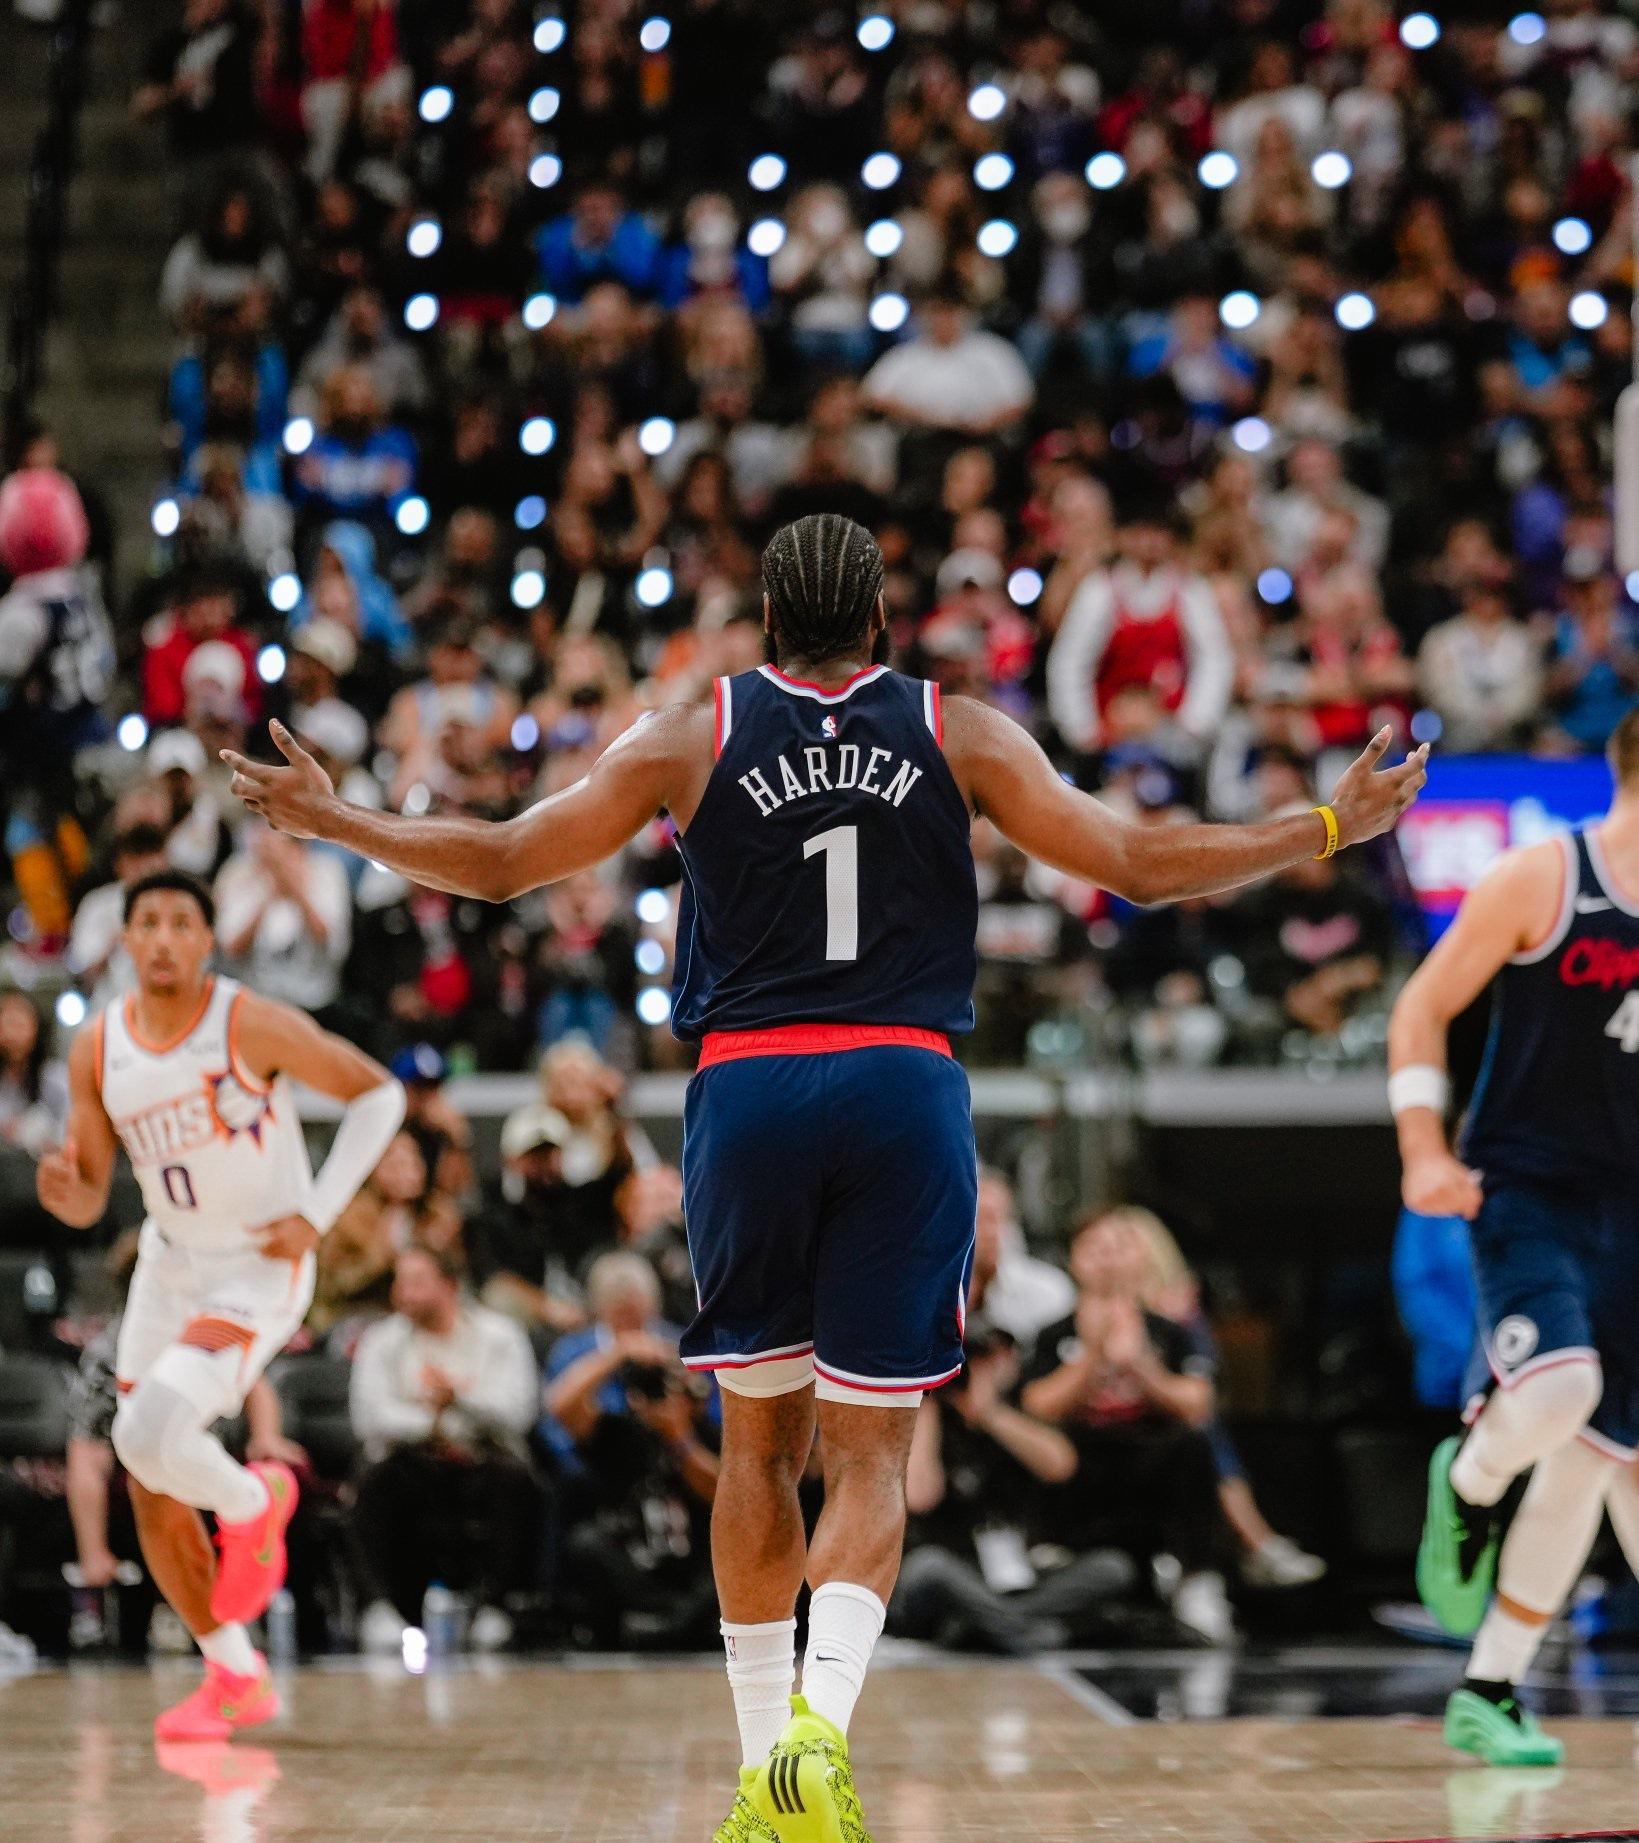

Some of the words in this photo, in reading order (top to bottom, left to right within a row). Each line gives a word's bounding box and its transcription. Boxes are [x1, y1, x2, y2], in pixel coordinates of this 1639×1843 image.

[737, 744, 923, 818] HARDEN
[802, 825, 858, 961] 1
[162, 1165, 198, 1210] 0
